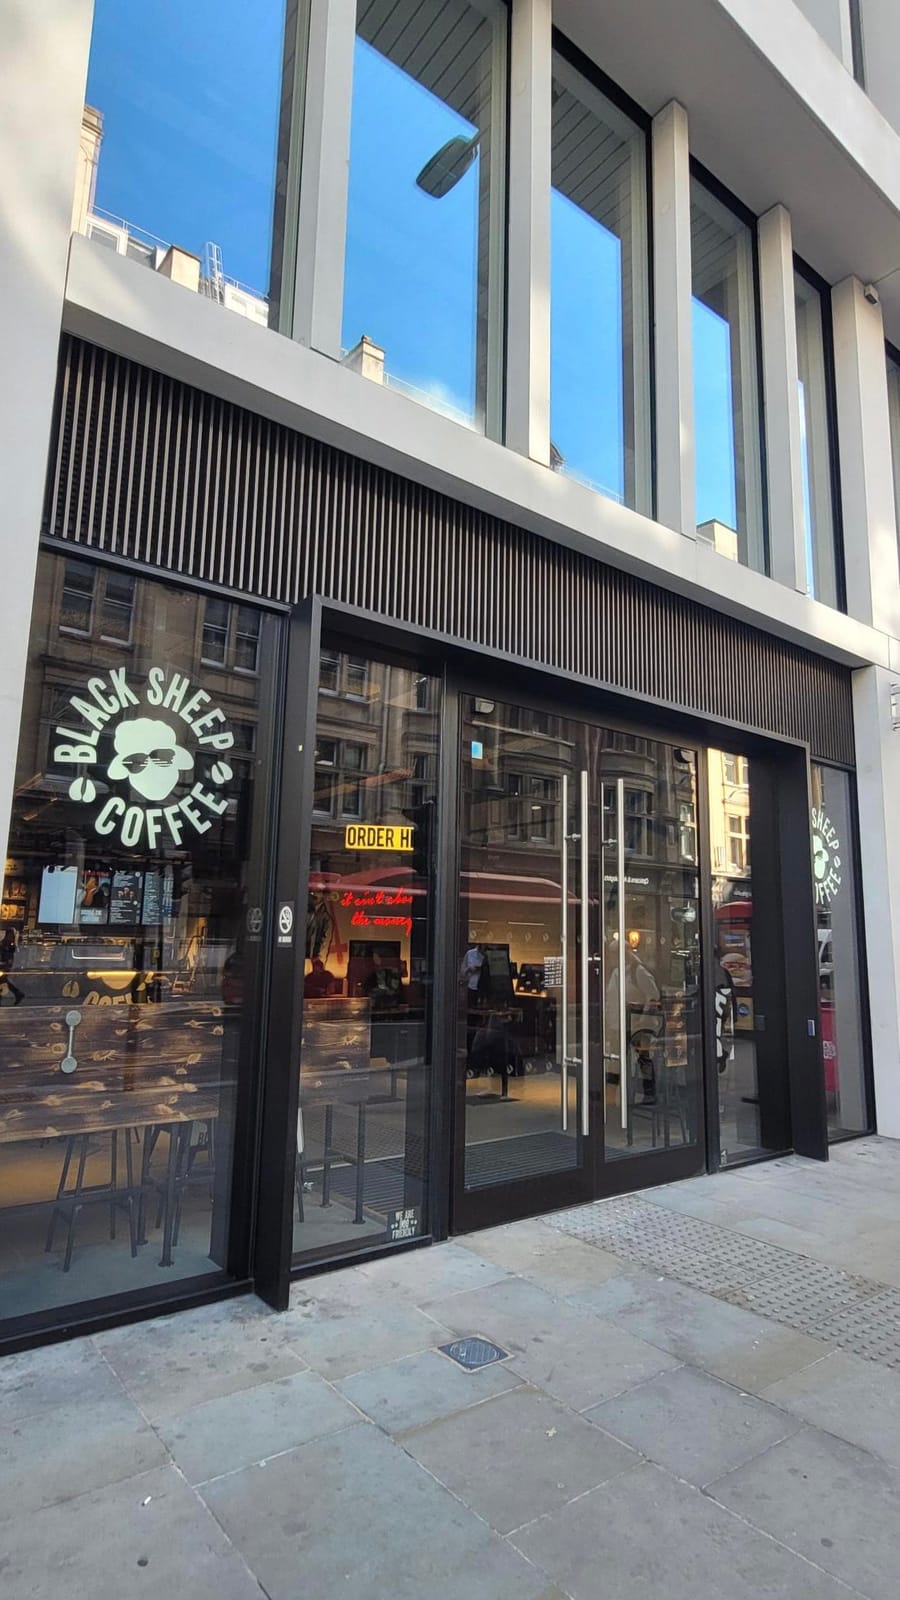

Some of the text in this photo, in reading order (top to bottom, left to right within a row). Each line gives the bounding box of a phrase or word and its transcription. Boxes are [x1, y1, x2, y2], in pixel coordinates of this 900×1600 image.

[54, 666, 235, 764] BLACK SHEEP
[94, 781, 229, 850] COFFEE
[347, 826, 414, 849] ORDER H
[811, 807, 840, 850] SHEEP
